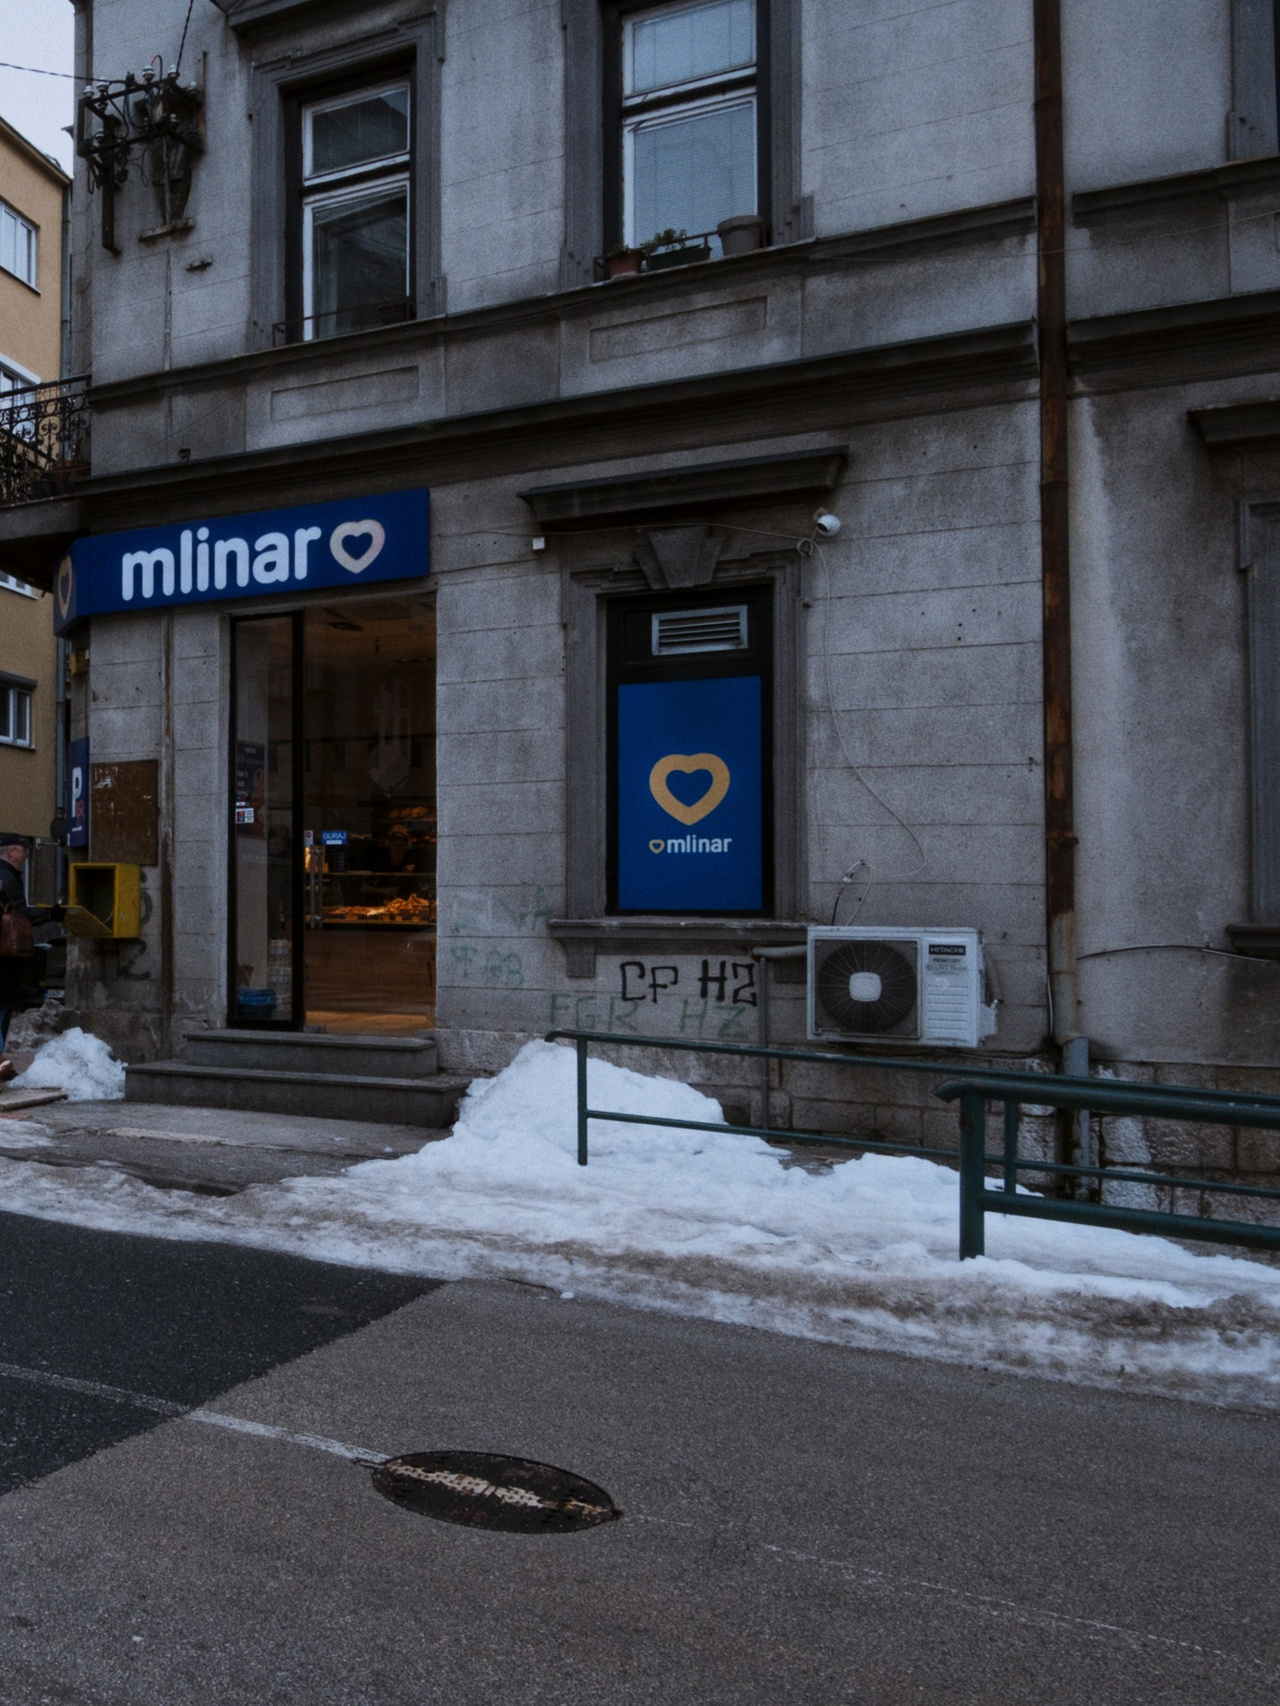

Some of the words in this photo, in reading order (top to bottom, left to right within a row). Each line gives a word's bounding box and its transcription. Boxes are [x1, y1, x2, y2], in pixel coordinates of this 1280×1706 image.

[122, 526, 322, 601] mlinar
[322, 832, 346, 840] GURAJ
[666, 834, 732, 854] mlinar
[930, 946, 964, 954] HITACHI
